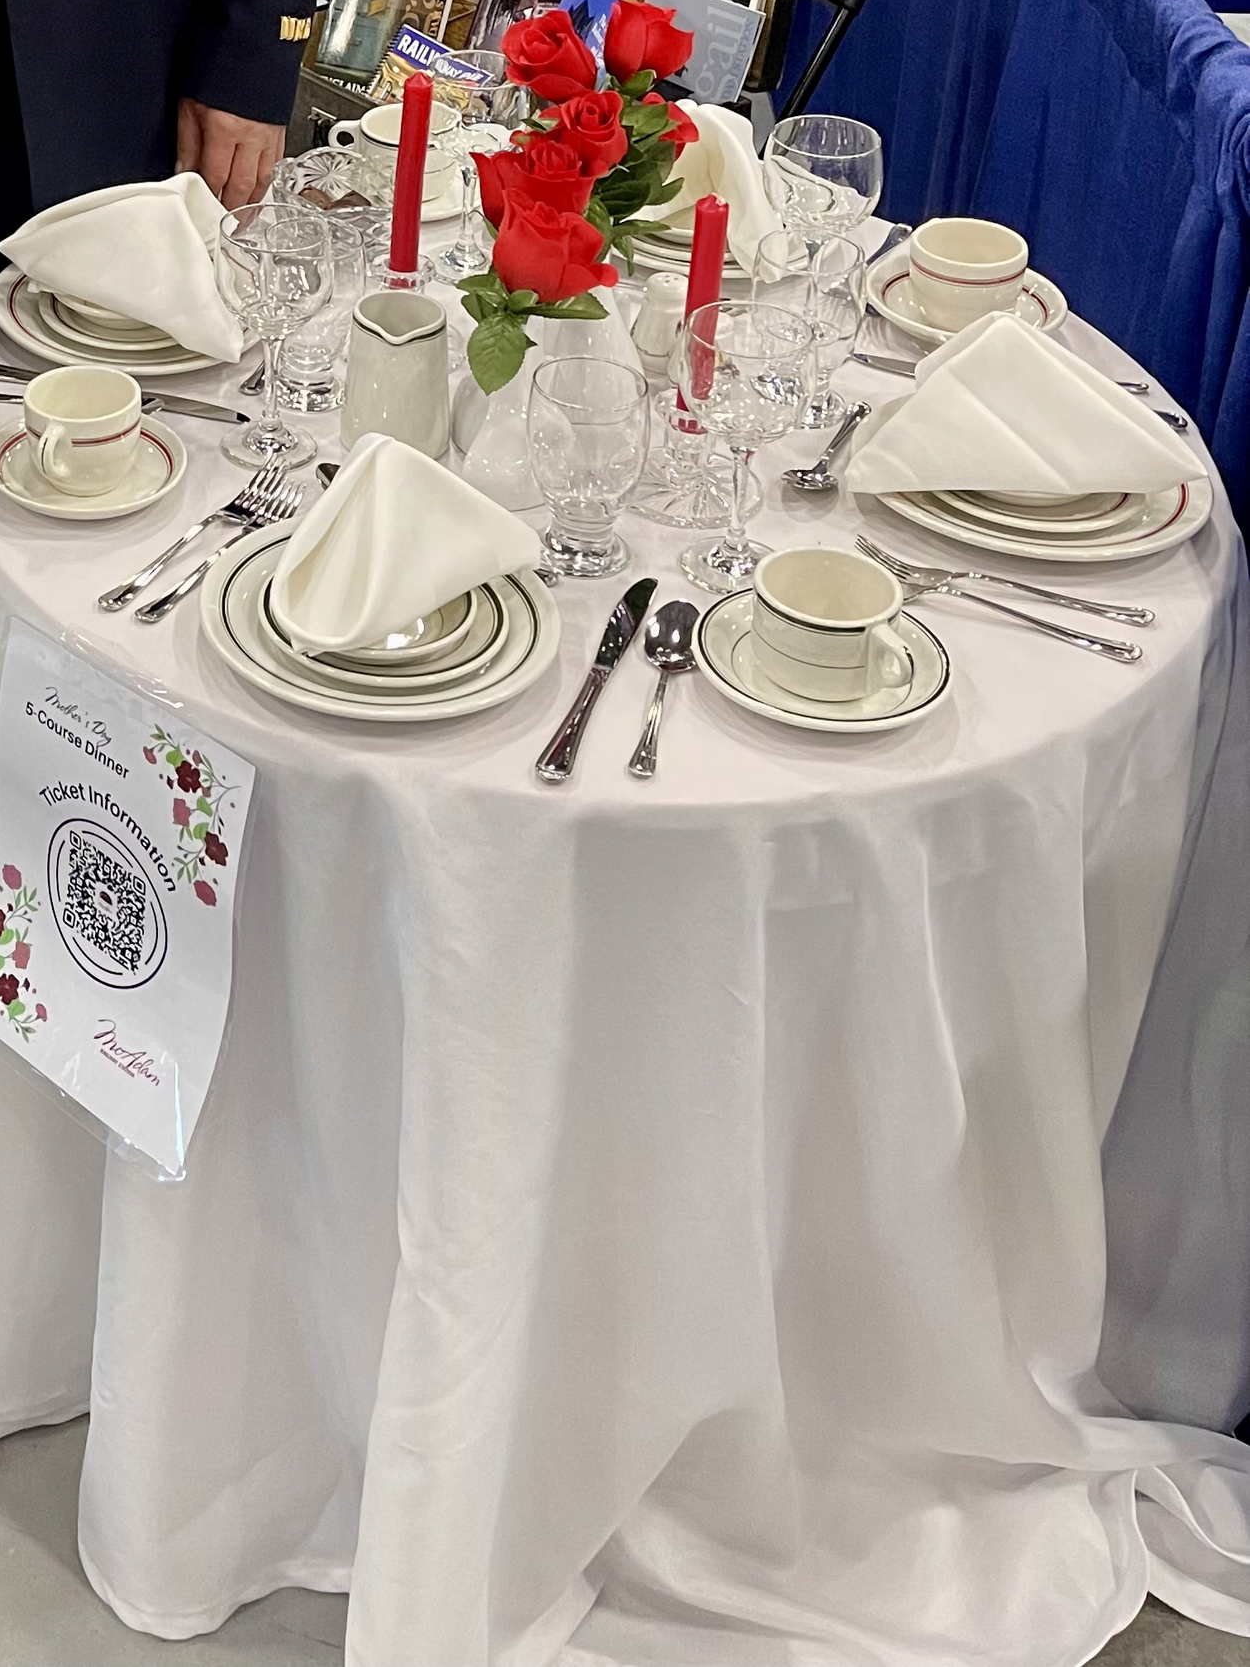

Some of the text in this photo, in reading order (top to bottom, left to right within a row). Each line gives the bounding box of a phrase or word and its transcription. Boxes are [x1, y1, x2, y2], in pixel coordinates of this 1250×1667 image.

[25, 701, 129, 779] 5-Course Dinner
[45, 686, 90, 728] Mother's
[38, 780, 176, 893] Ticket Information
[93, 1019, 161, 1086] McAdam
